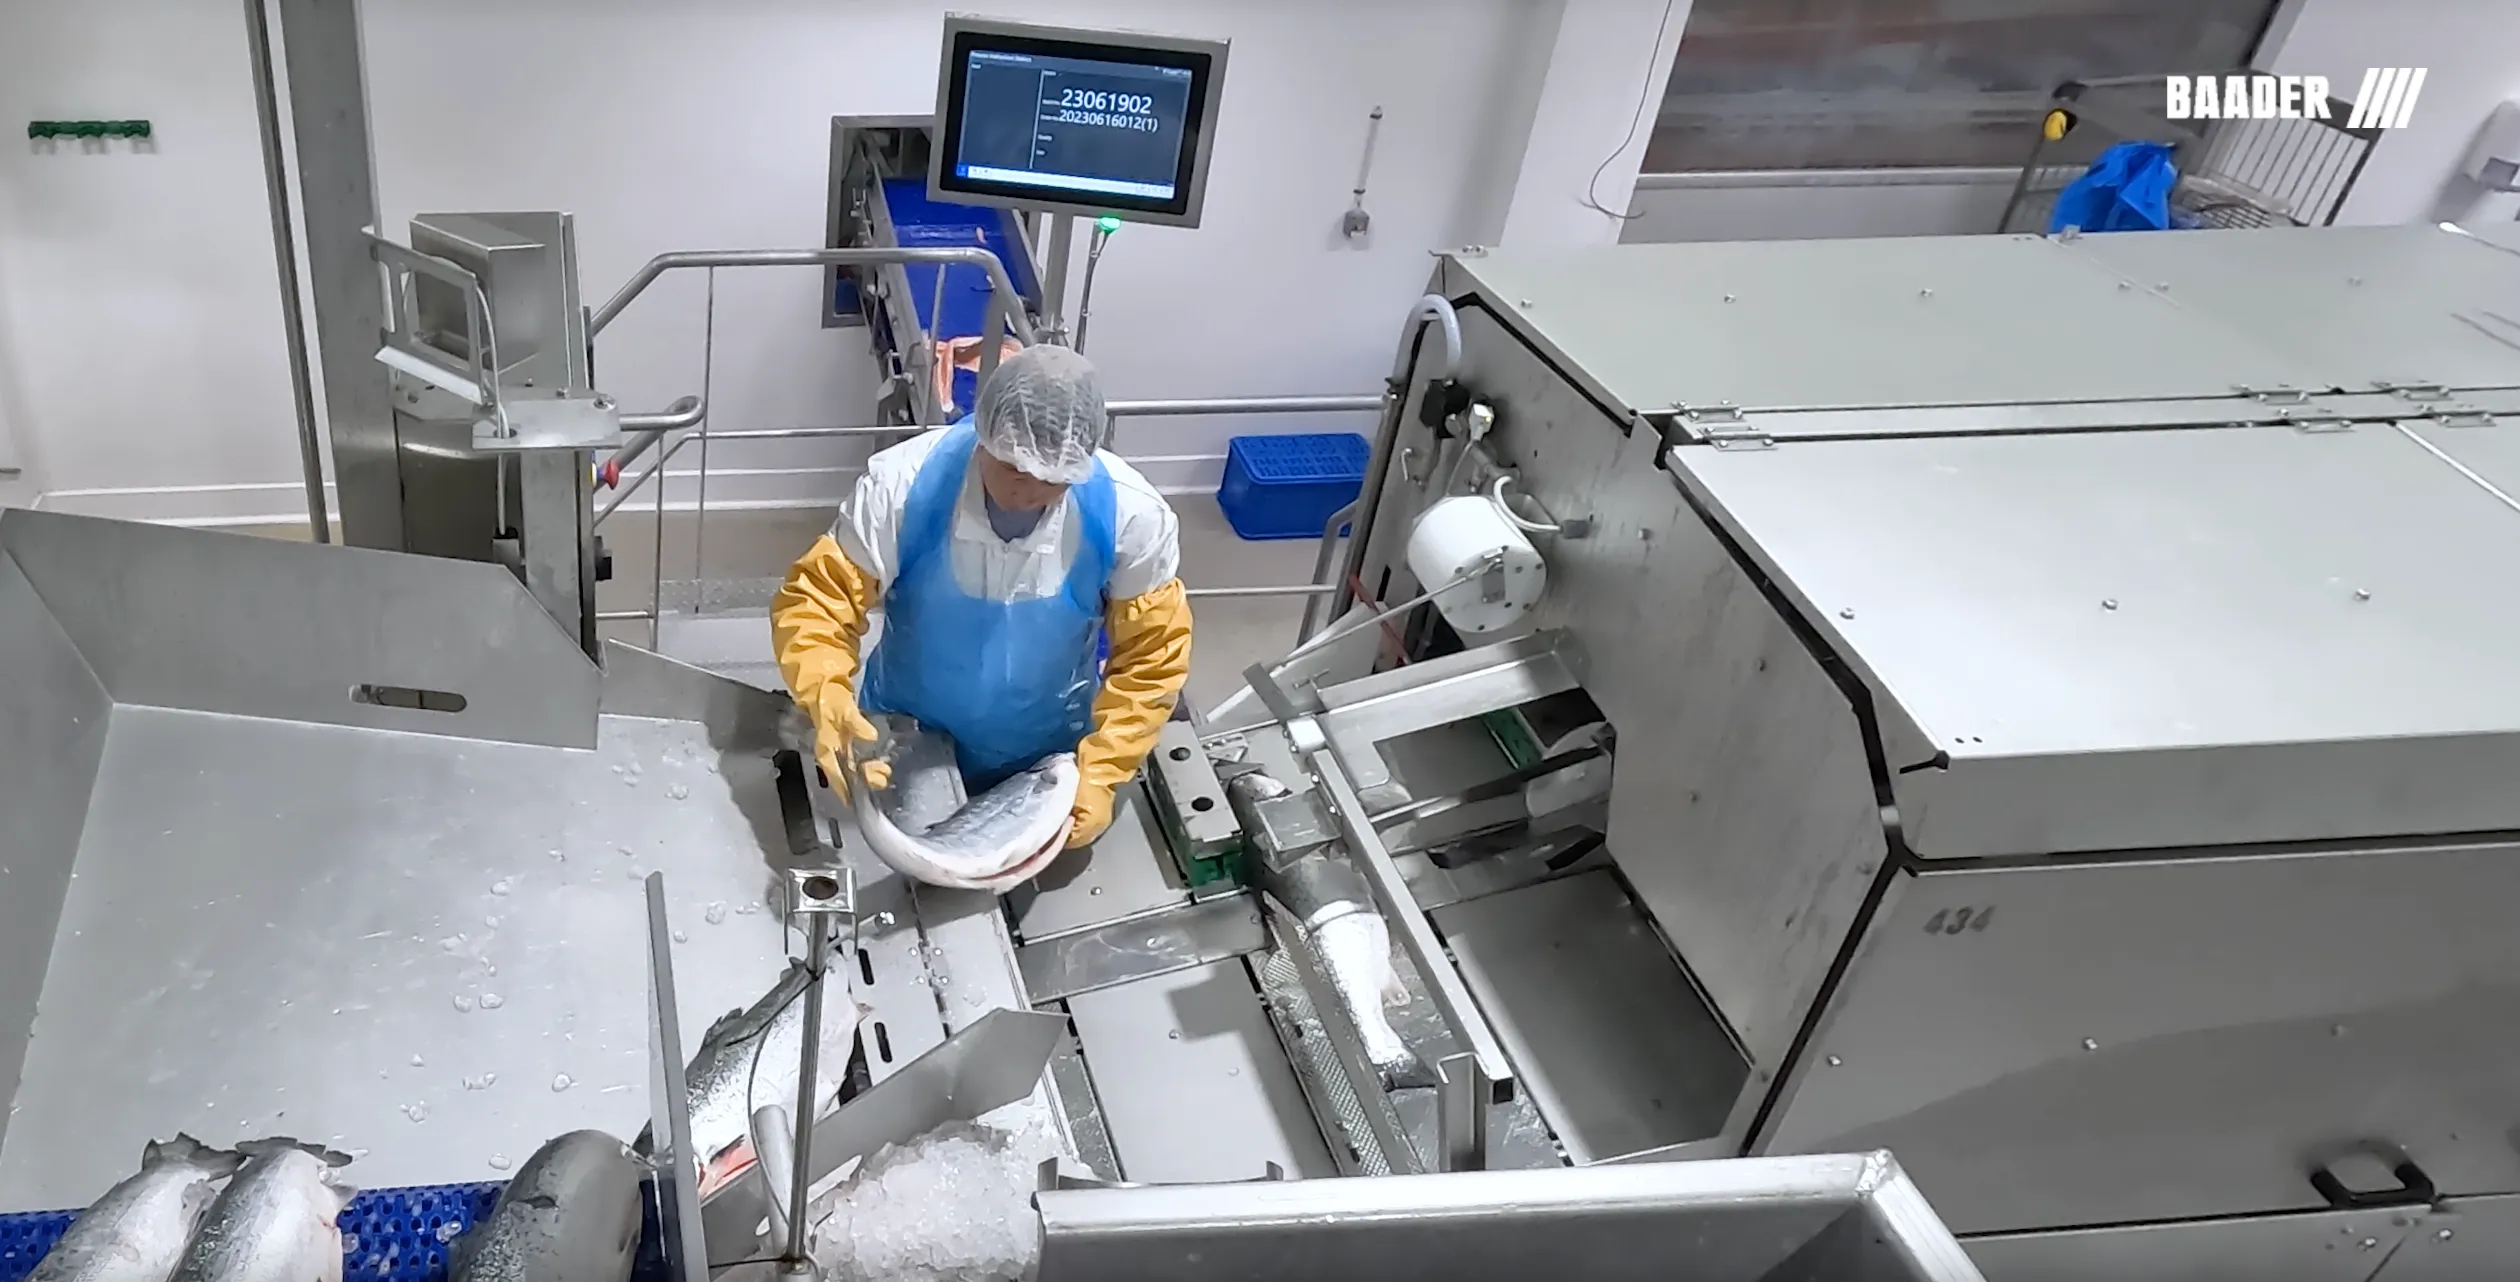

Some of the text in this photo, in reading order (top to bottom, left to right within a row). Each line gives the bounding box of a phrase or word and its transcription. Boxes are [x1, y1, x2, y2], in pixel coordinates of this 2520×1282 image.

[1061, 88, 1152, 114] 23061902
[1059, 110, 1158, 132] 20230616012(1)
[1923, 905, 1996, 936] 434
